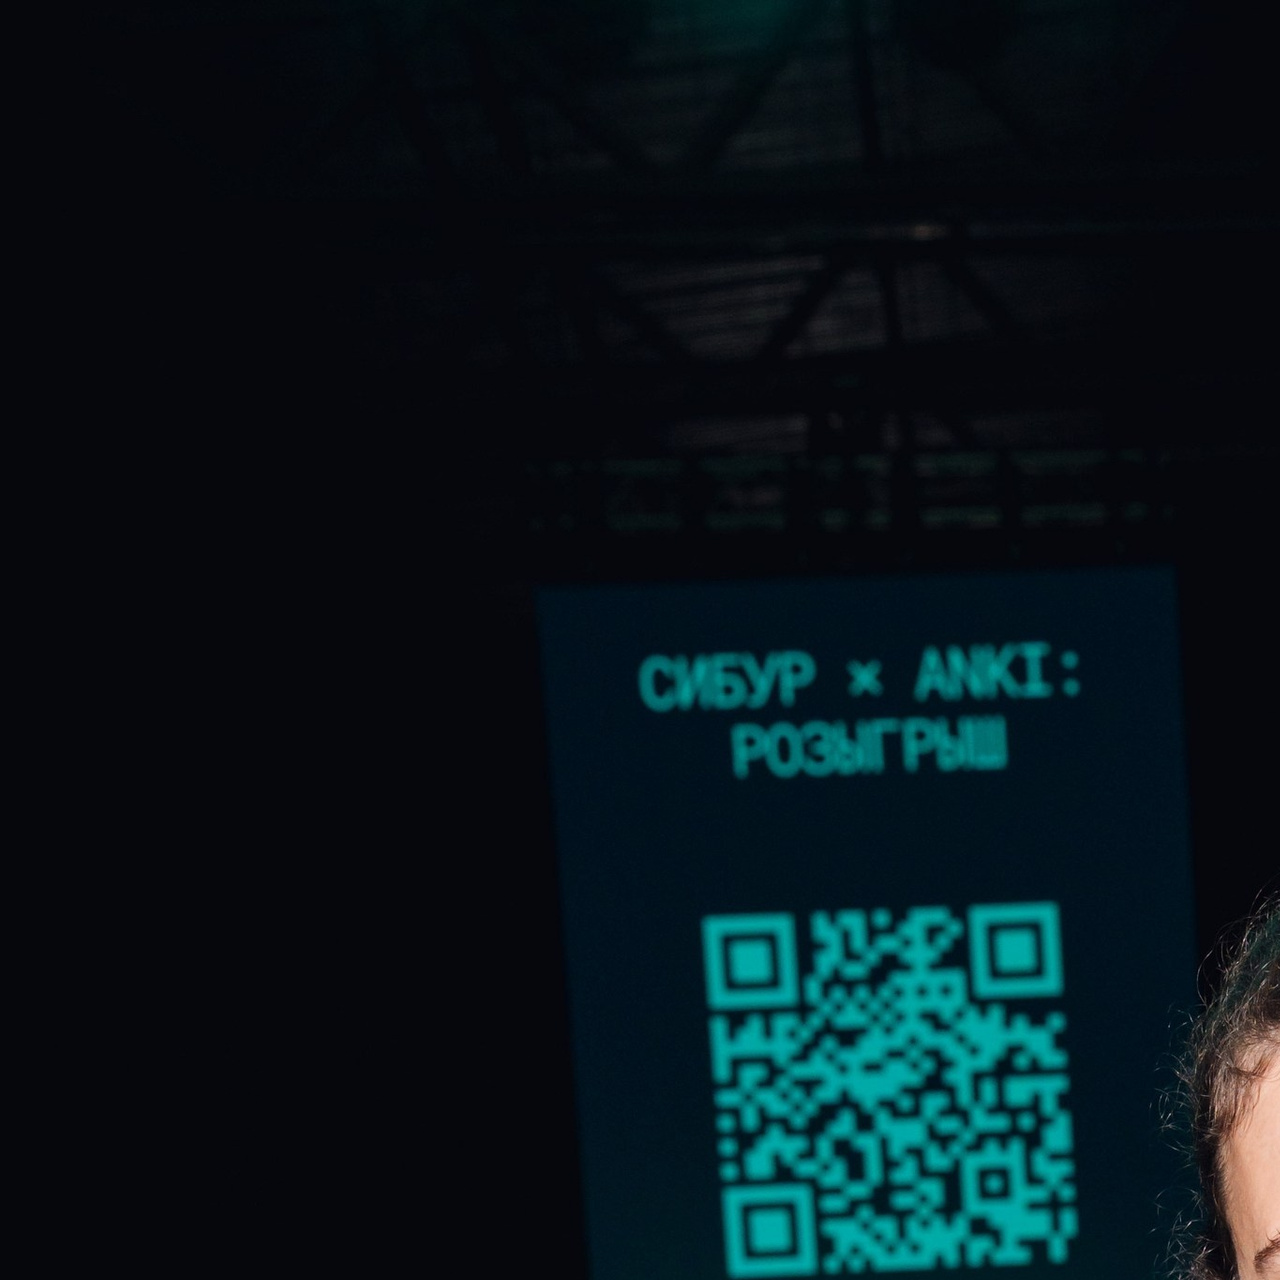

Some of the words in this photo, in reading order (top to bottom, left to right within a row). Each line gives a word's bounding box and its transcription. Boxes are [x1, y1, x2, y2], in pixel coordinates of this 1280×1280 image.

[638, 650, 817, 711] СИБУР
[913, 641, 1080, 700] ANKI:
[730, 714, 1008, 779] РОЗЫГРЫШ
